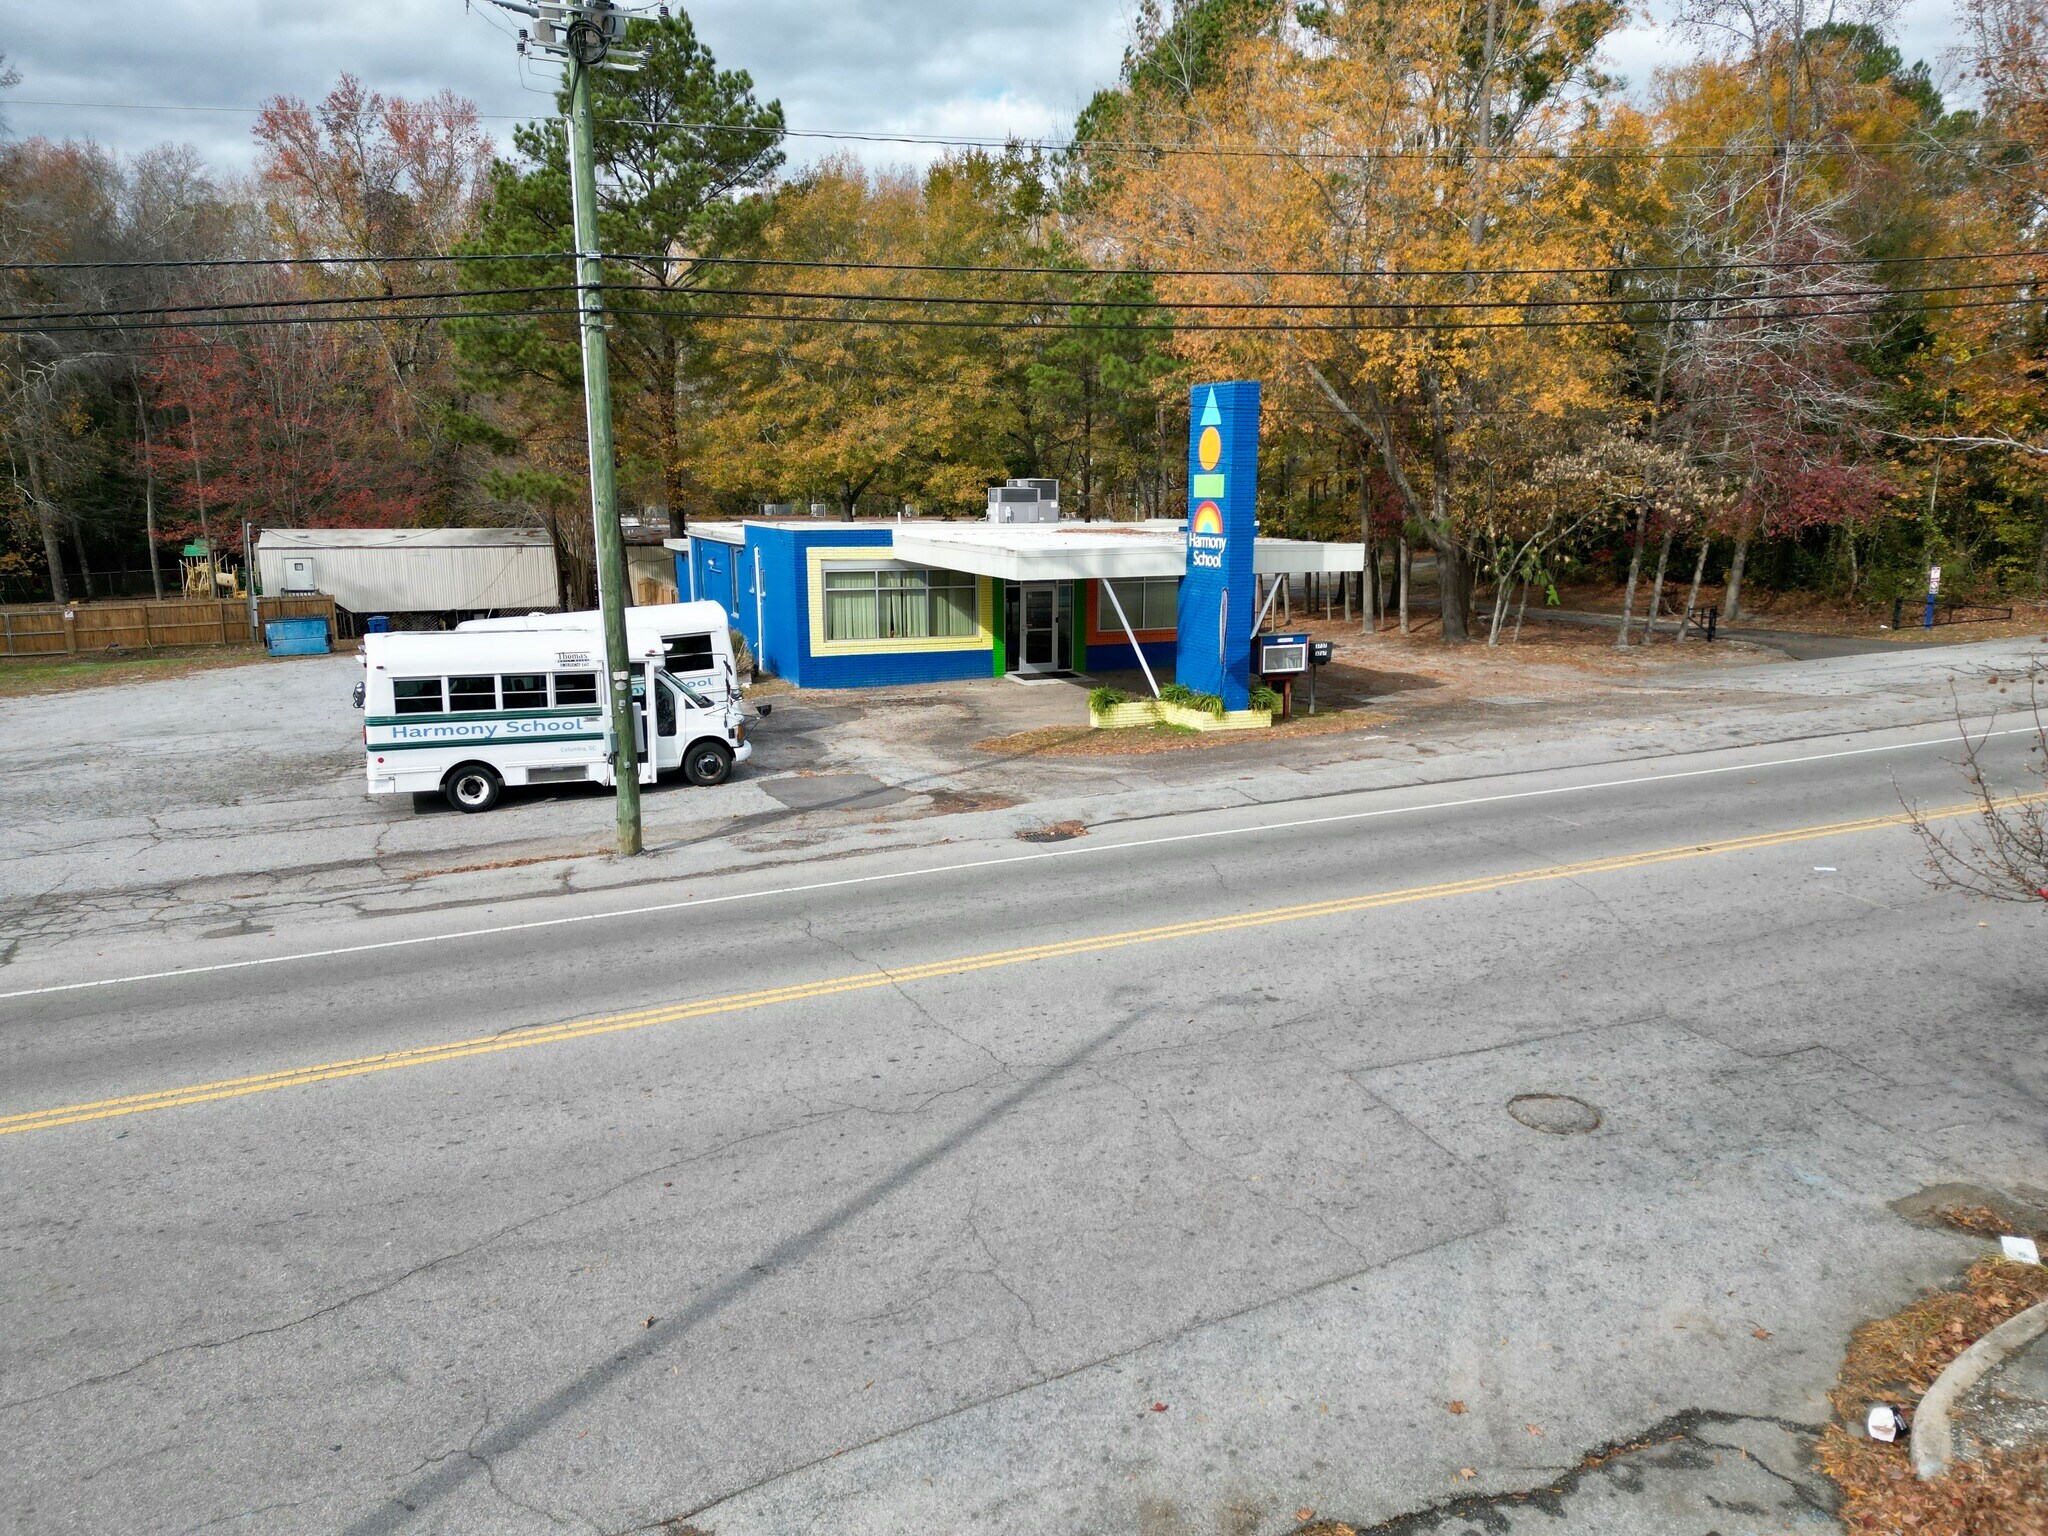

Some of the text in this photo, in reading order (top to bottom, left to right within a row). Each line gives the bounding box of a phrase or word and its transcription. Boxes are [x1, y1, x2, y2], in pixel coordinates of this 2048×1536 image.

[1189, 533, 1227, 553] Harmony
[1193, 550, 1222, 568] School
[392, 718, 583, 741] Harmony School
